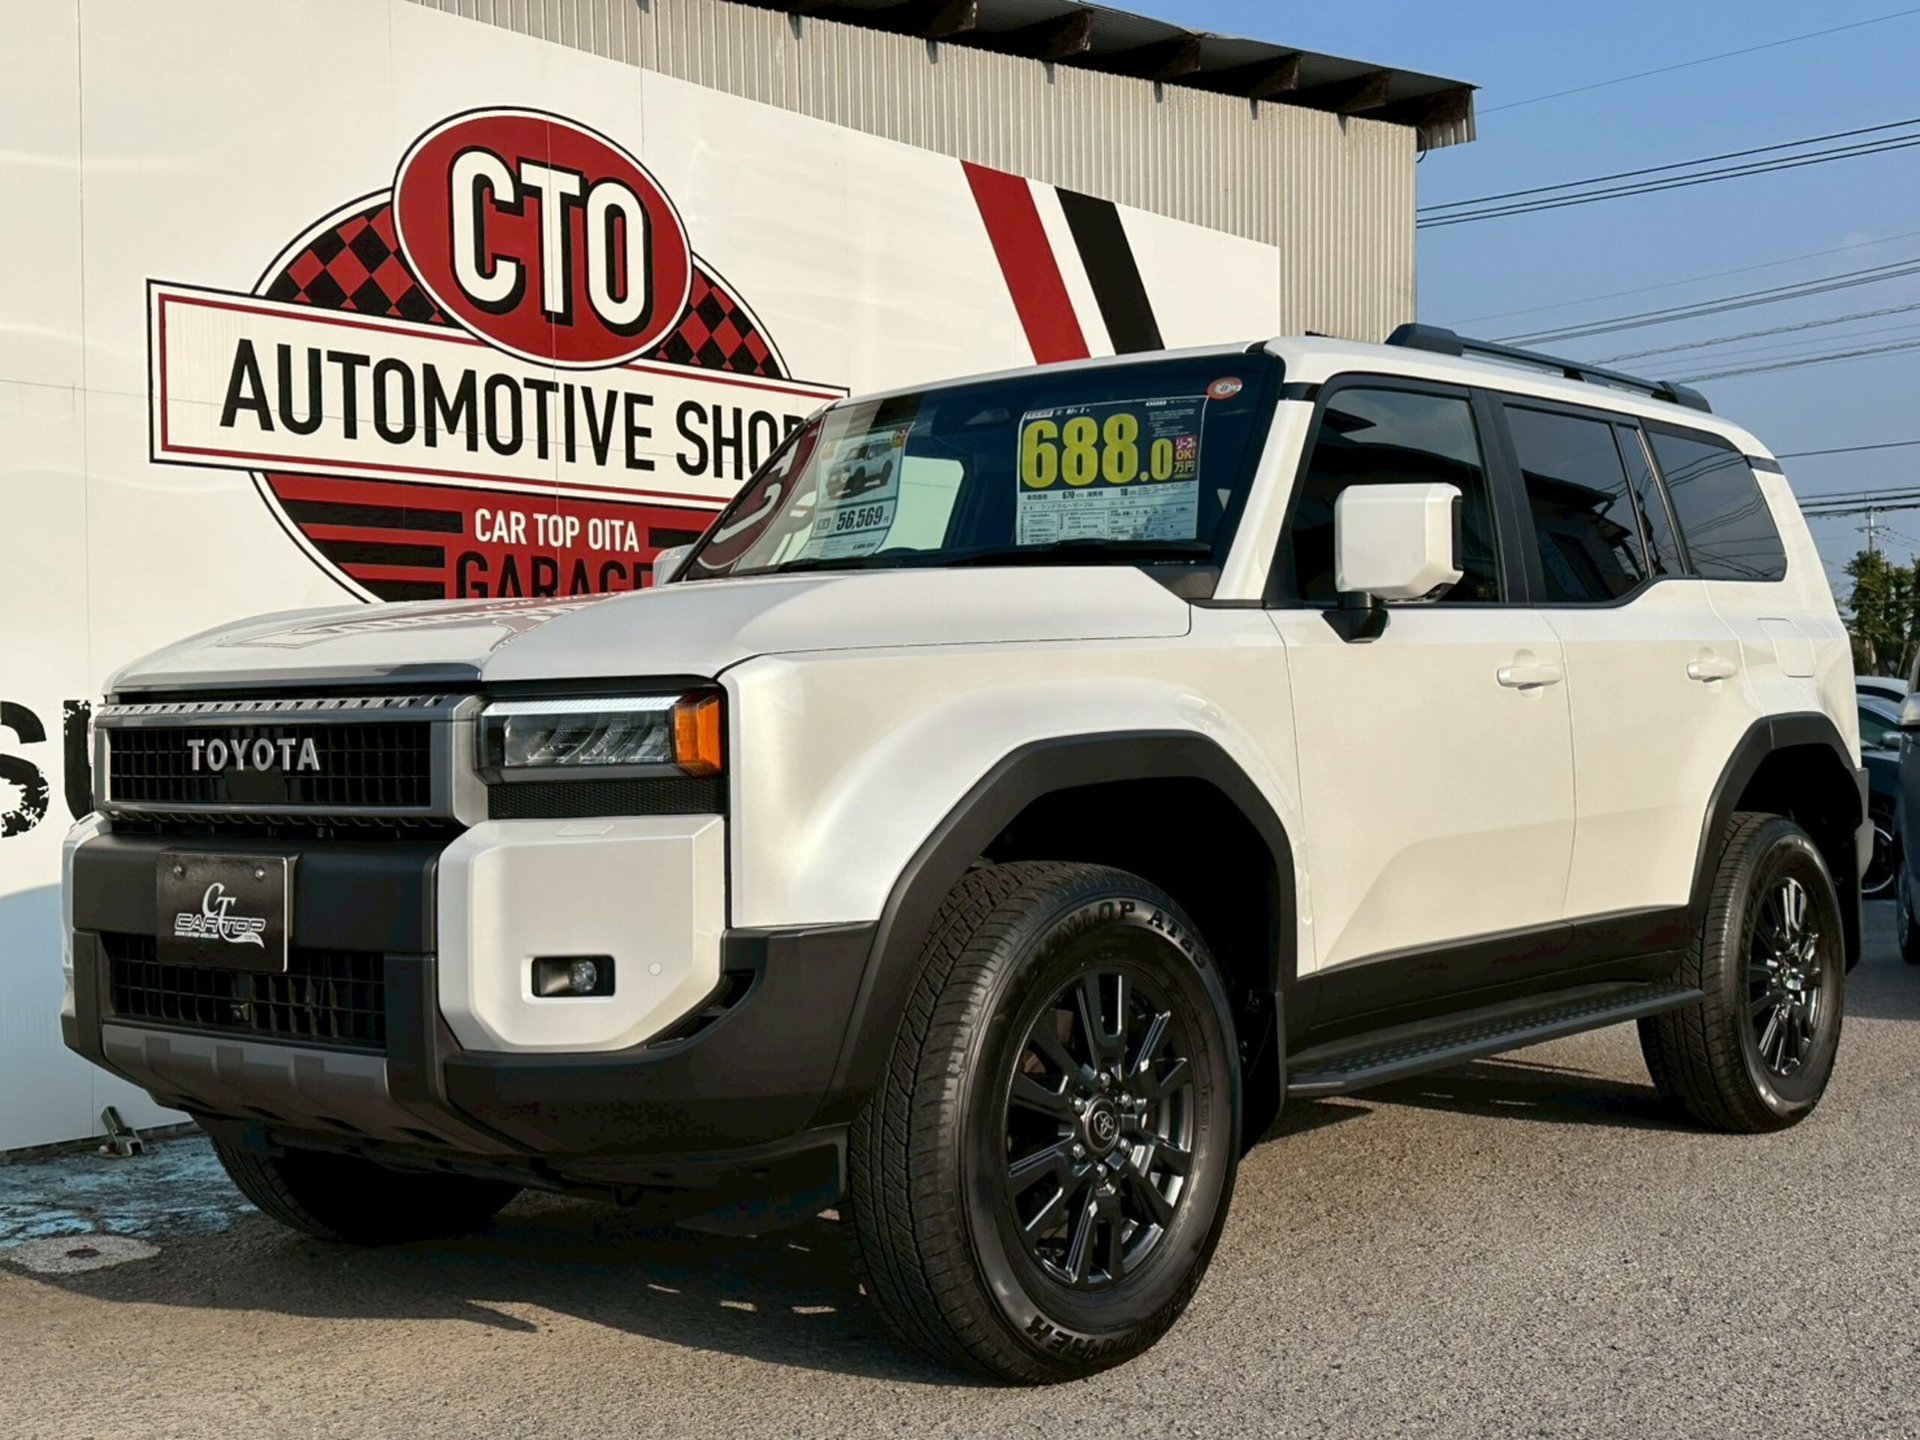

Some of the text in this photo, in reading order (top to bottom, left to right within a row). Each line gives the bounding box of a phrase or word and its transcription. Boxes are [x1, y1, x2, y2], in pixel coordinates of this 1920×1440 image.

[449, 148, 651, 335] CTO
[219, 339, 655, 471] AUTOMOTIVE
[1022, 413, 1173, 488] 688.0
[475, 508, 640, 552] CAR TOP OITA
[187, 737, 320, 772] TOYOTA
